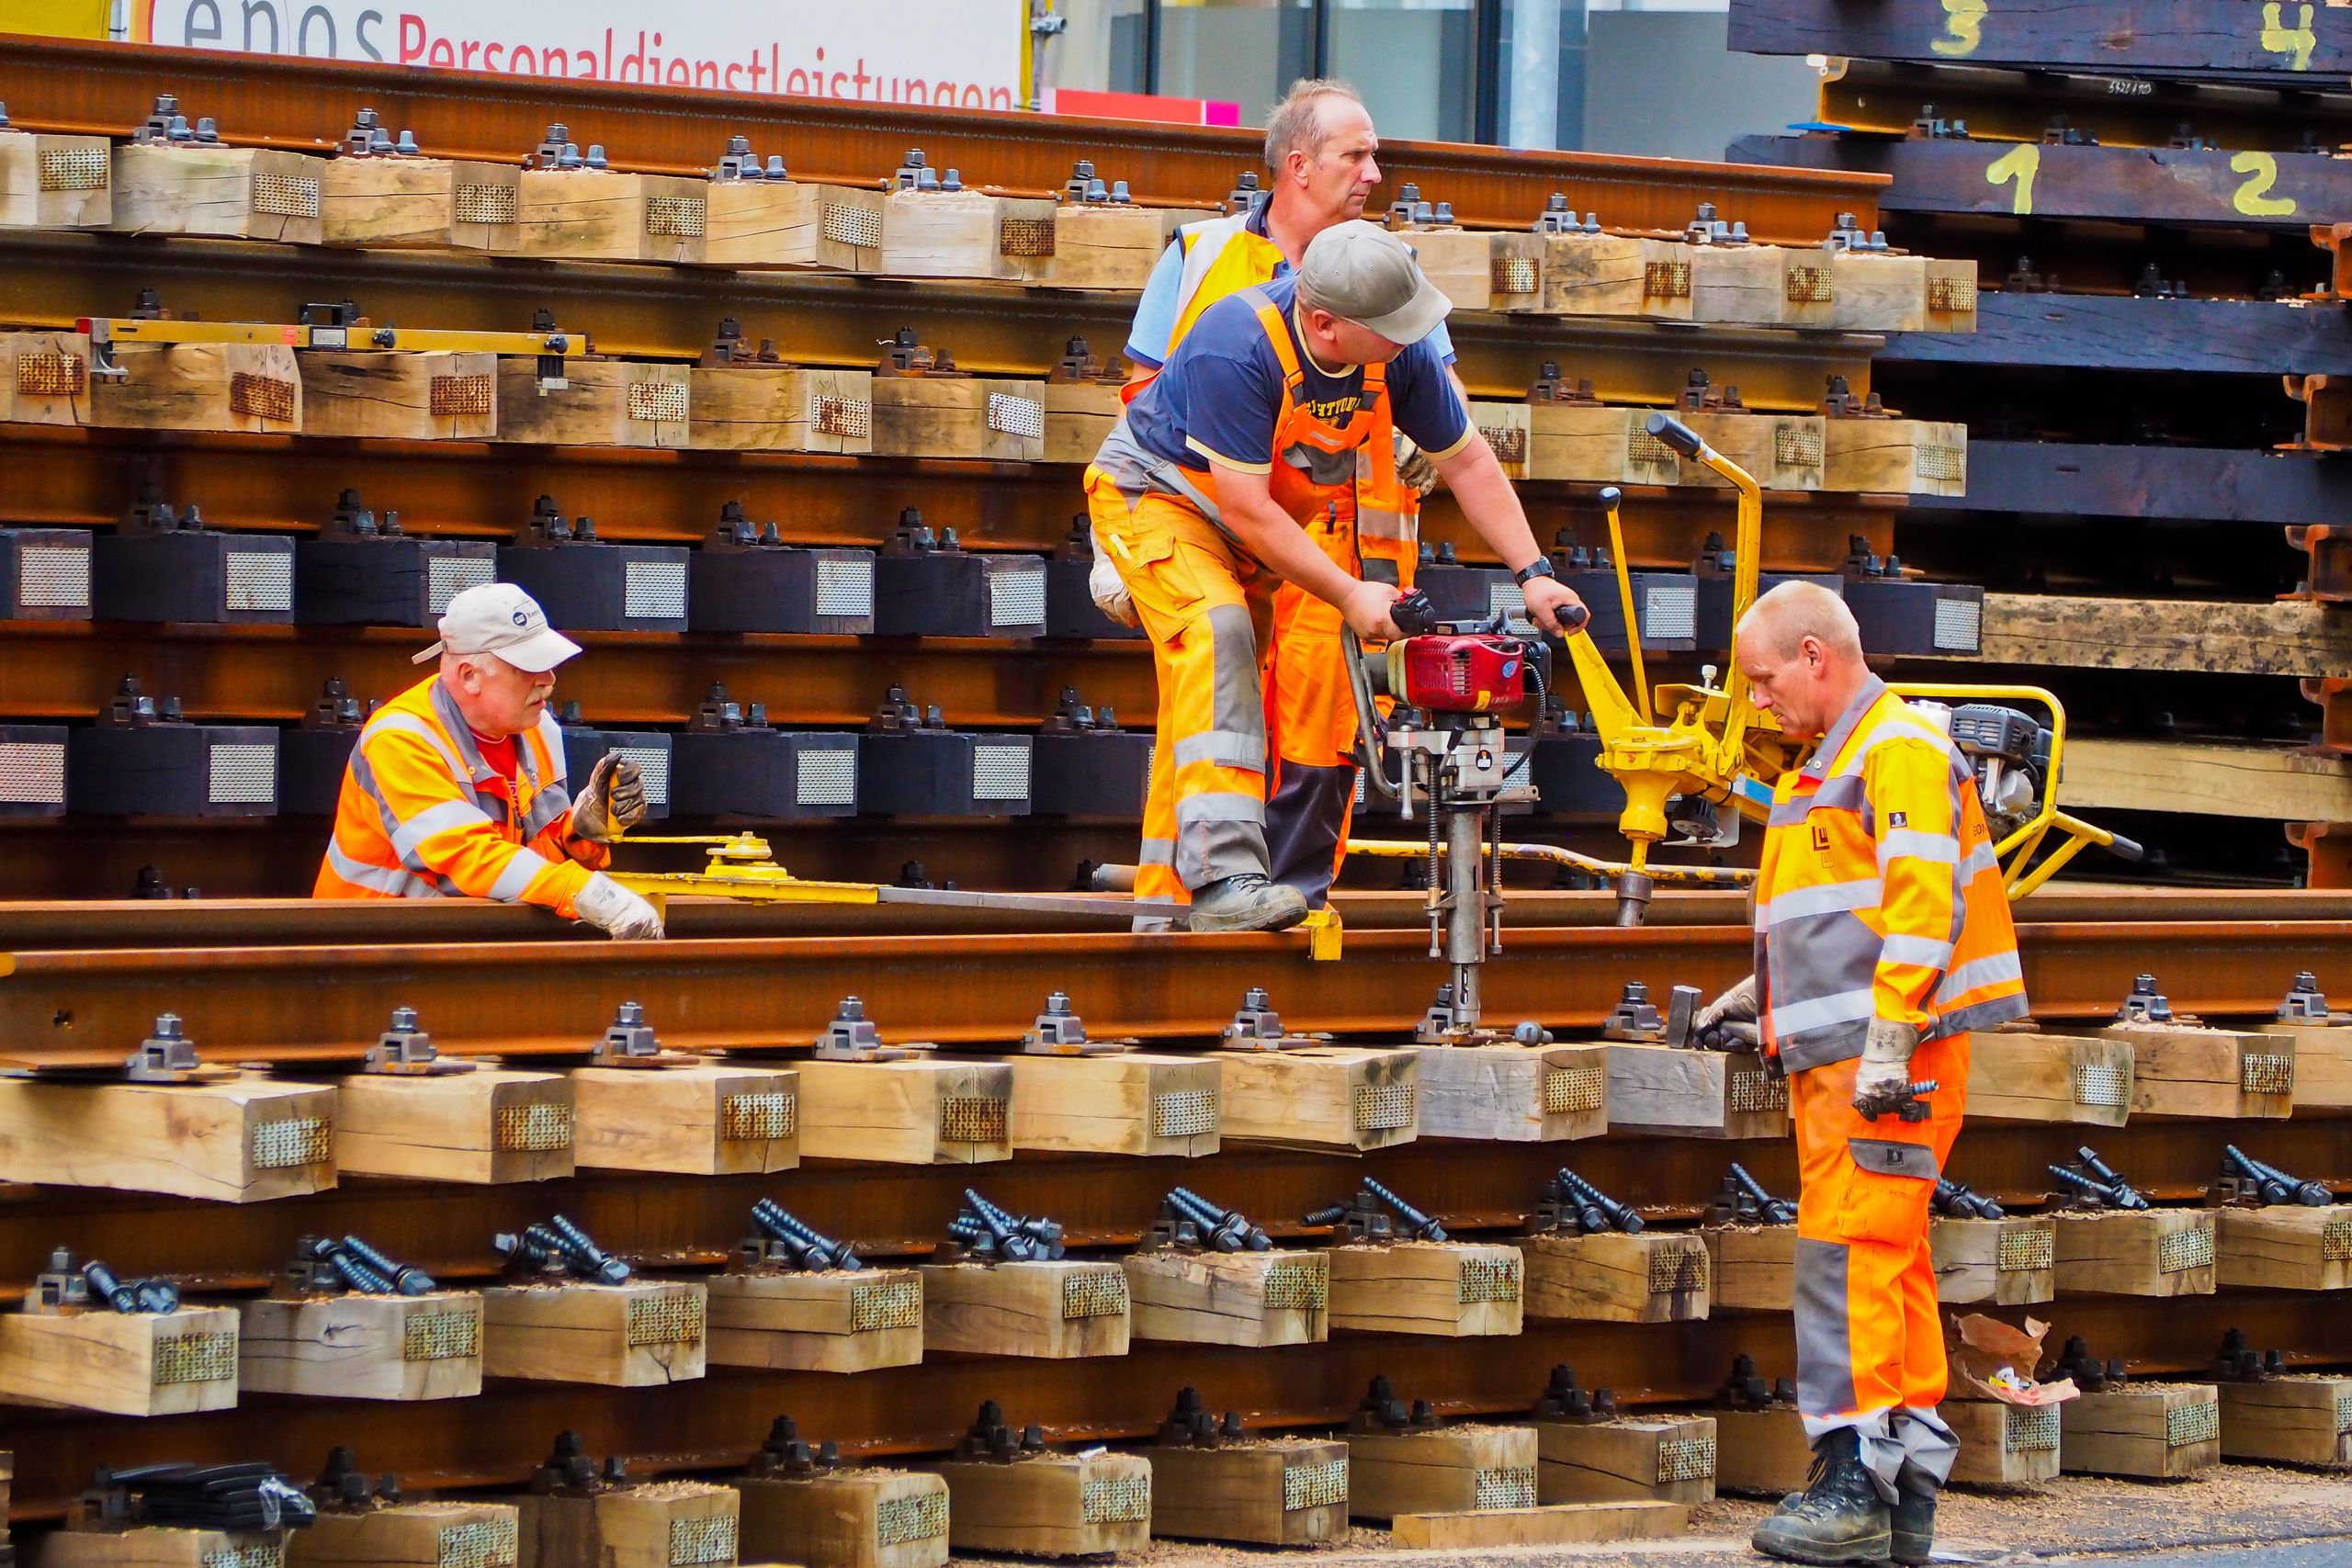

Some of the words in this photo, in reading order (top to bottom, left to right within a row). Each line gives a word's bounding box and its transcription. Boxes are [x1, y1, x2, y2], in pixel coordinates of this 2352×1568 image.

[1930, 0, 1989, 55] 3
[2260, 2, 2316, 72] 4
[1985, 142, 2041, 215] 1
[2230, 150, 2297, 217] 2
